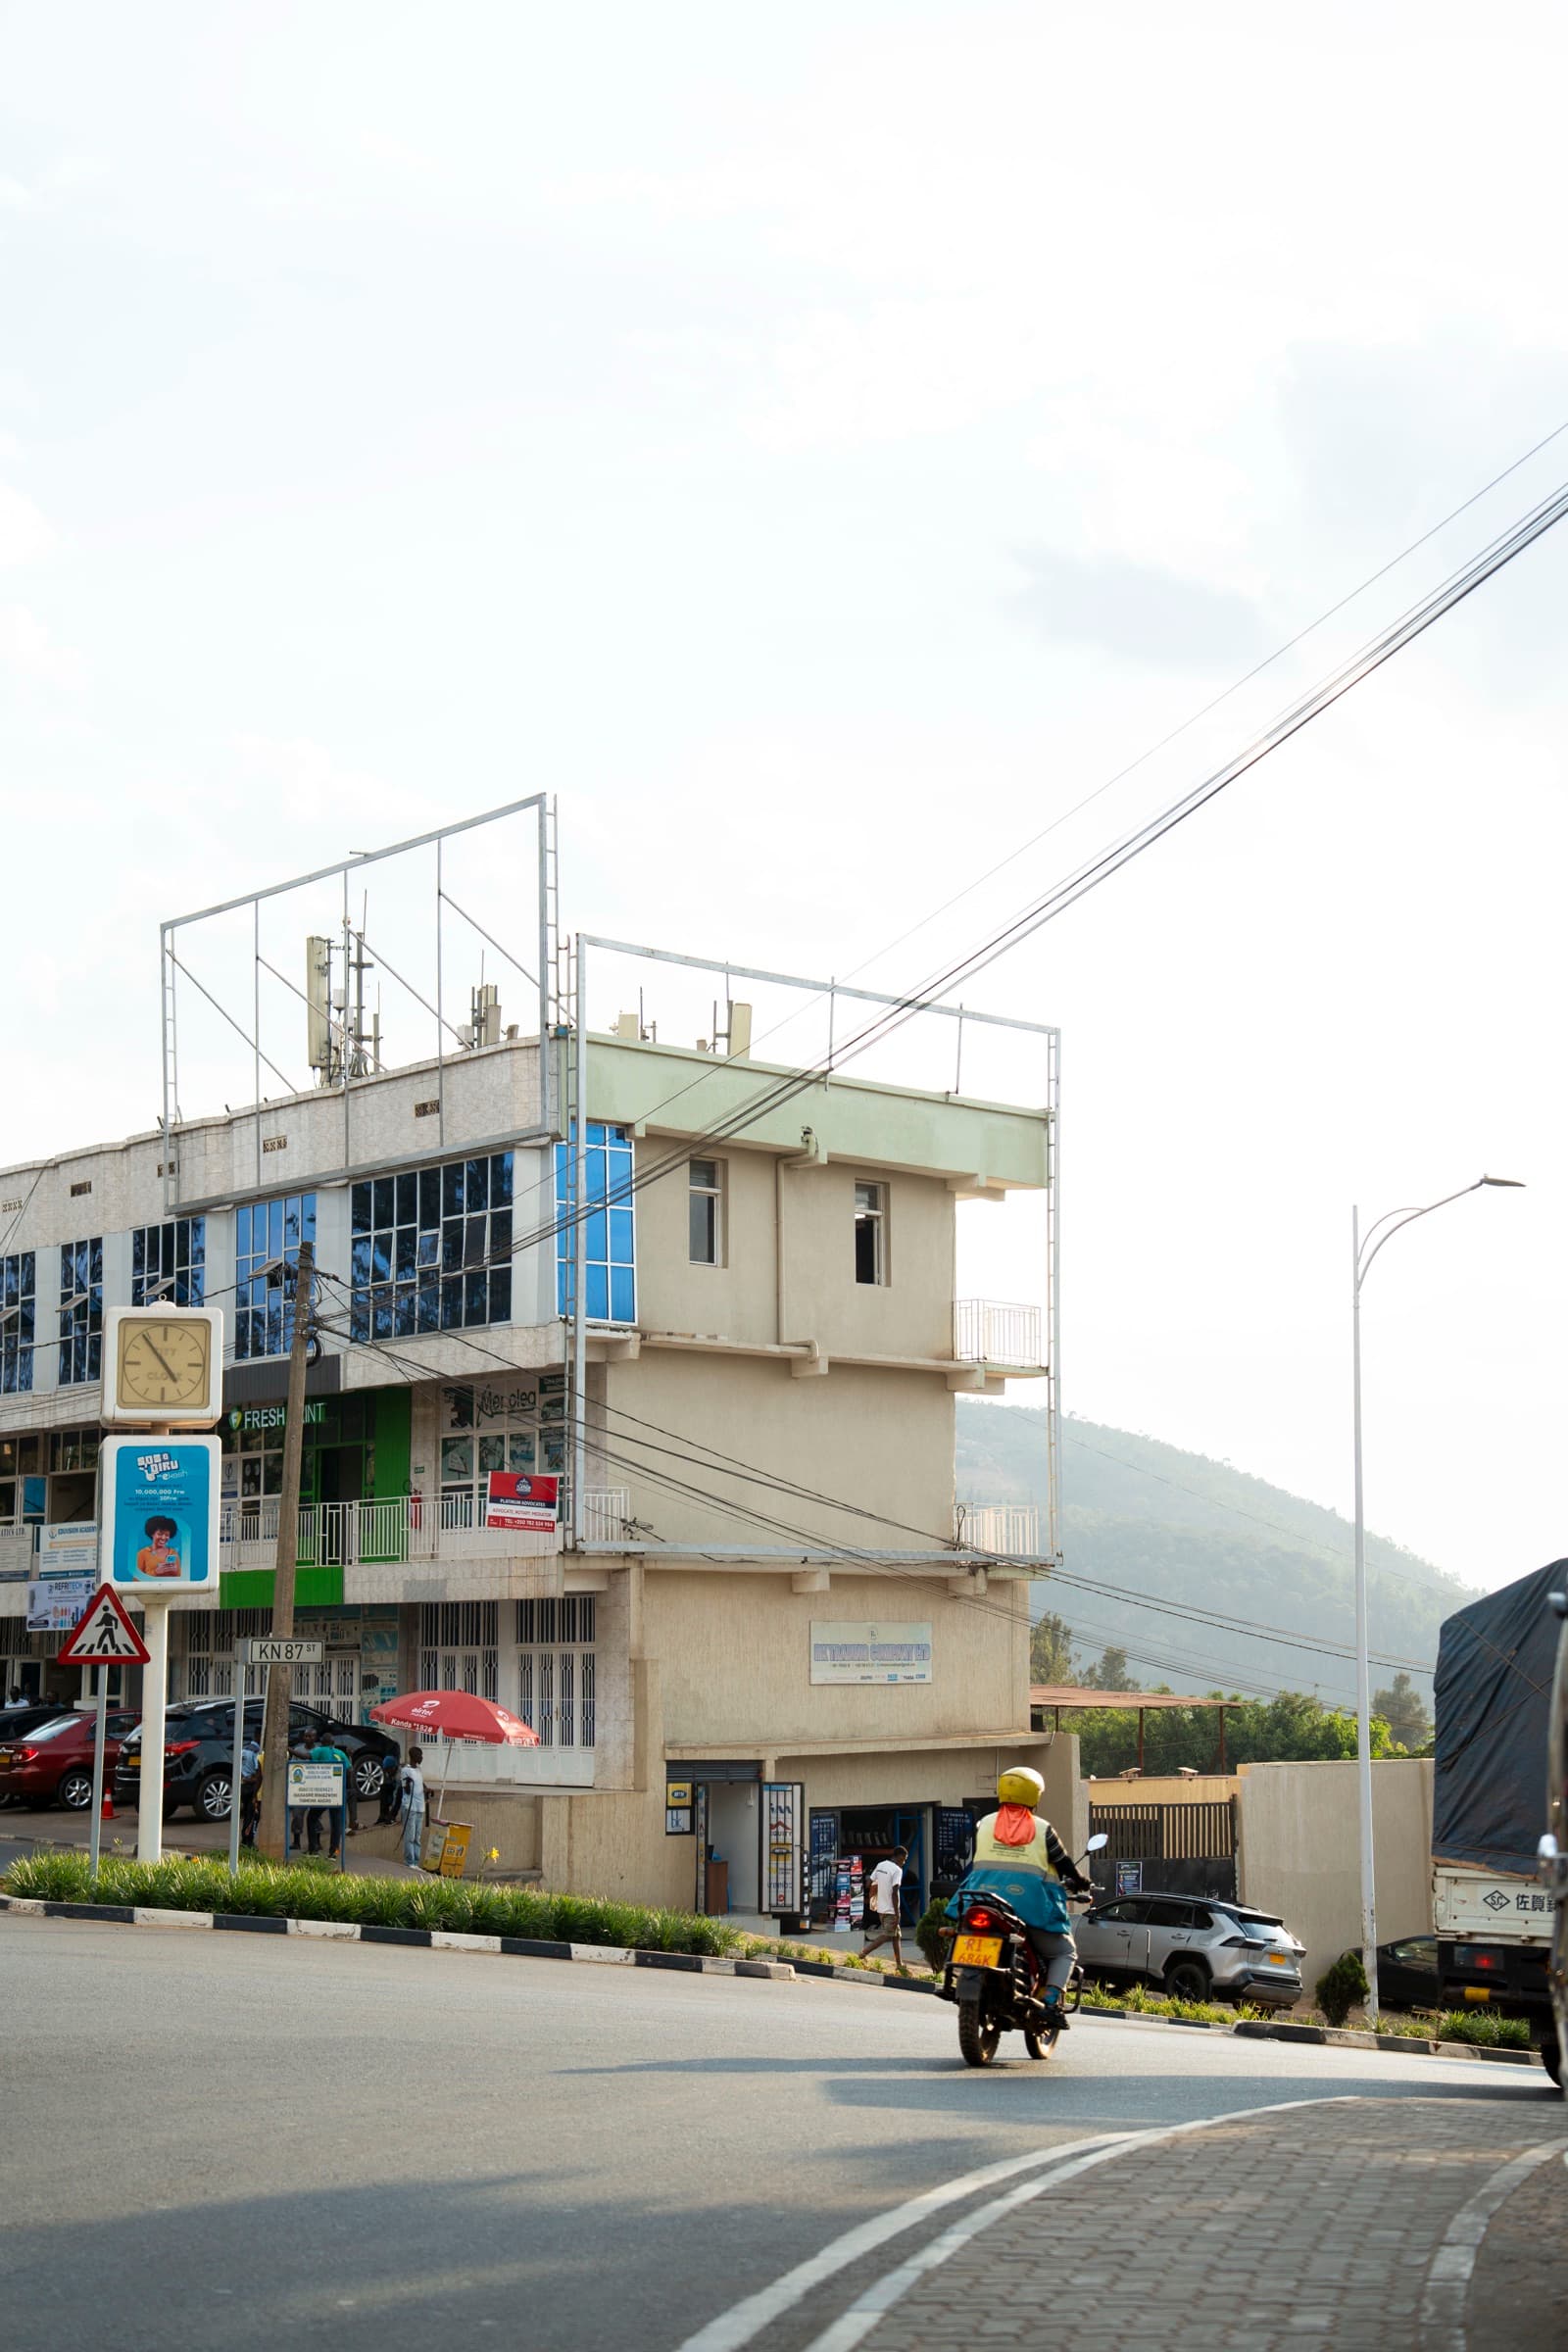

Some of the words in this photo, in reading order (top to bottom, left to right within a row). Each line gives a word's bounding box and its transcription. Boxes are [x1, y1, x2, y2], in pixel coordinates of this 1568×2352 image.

[147, 1372, 182, 1381] CLOK
[244, 1406, 285, 1429] FRESH
[259, 1643, 281, 1659] KN
[285, 1643, 304, 1659] 87
[391, 1718, 412, 1729] Kanda
